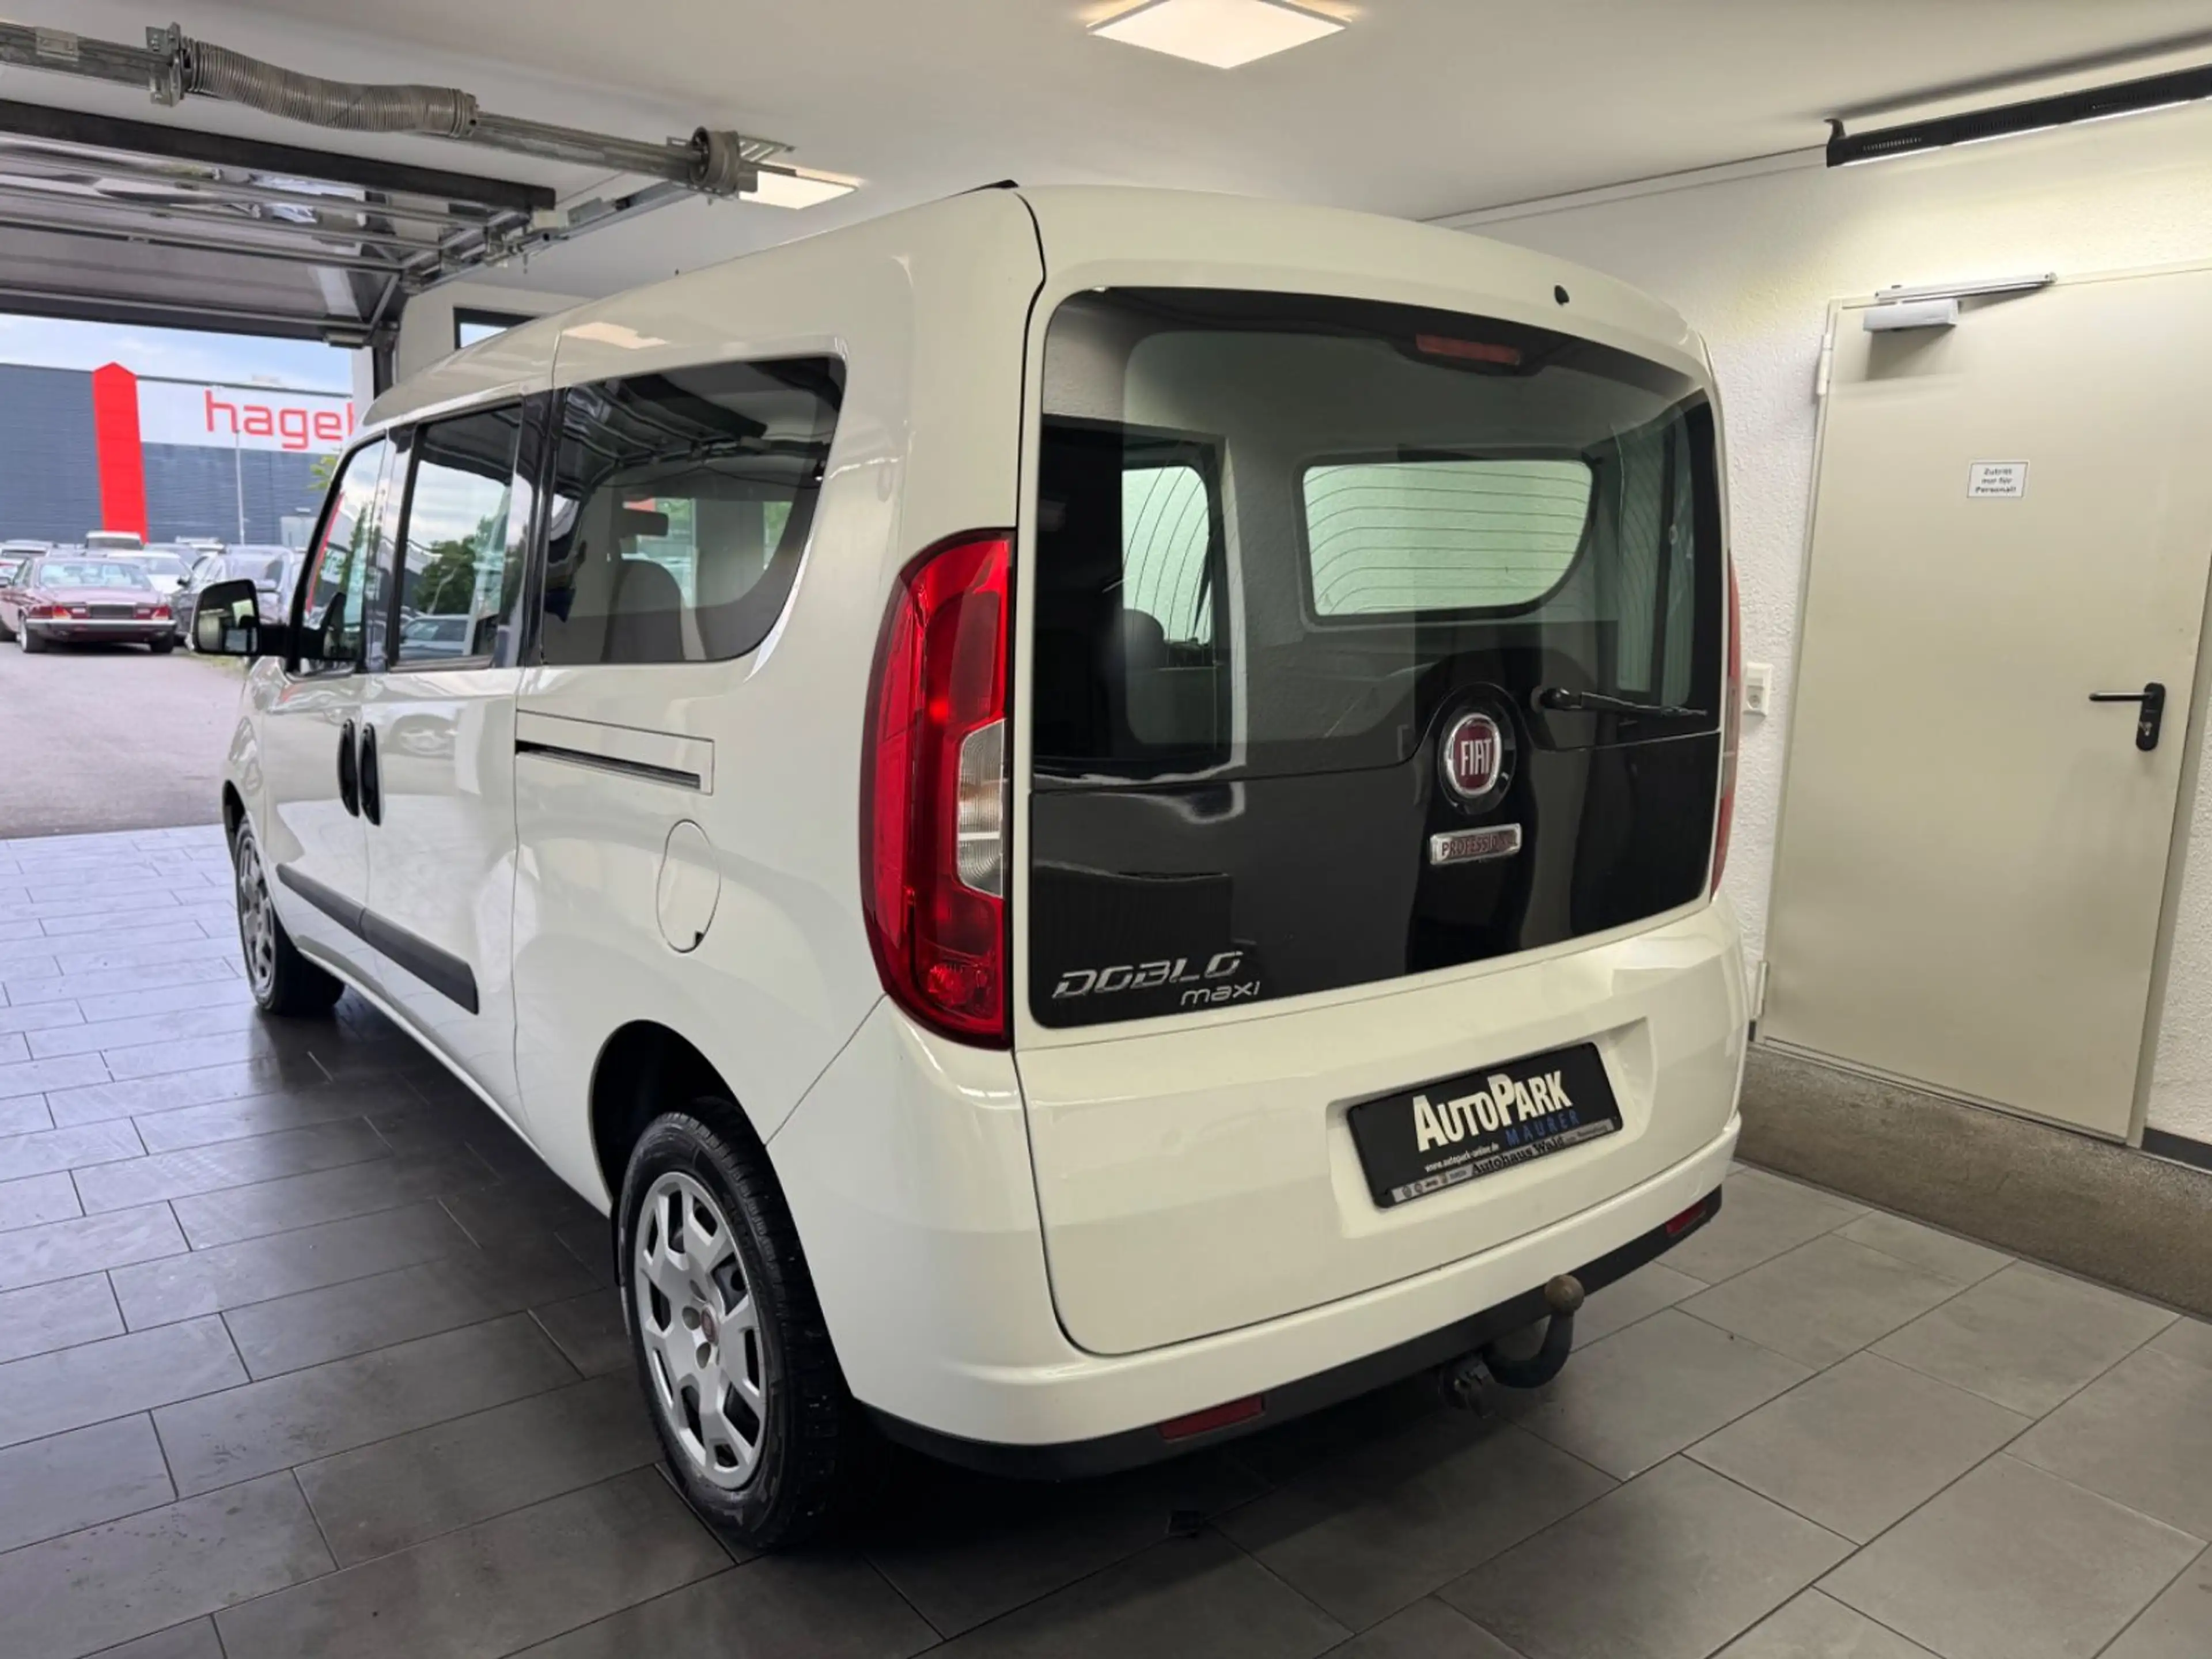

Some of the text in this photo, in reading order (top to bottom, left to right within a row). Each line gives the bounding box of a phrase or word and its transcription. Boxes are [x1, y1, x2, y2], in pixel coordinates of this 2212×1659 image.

[1460, 738, 1492, 776] FIAT
[1505, 1109, 1580, 1146] MAURER
[1471, 1147, 1533, 1176] Autohaus
